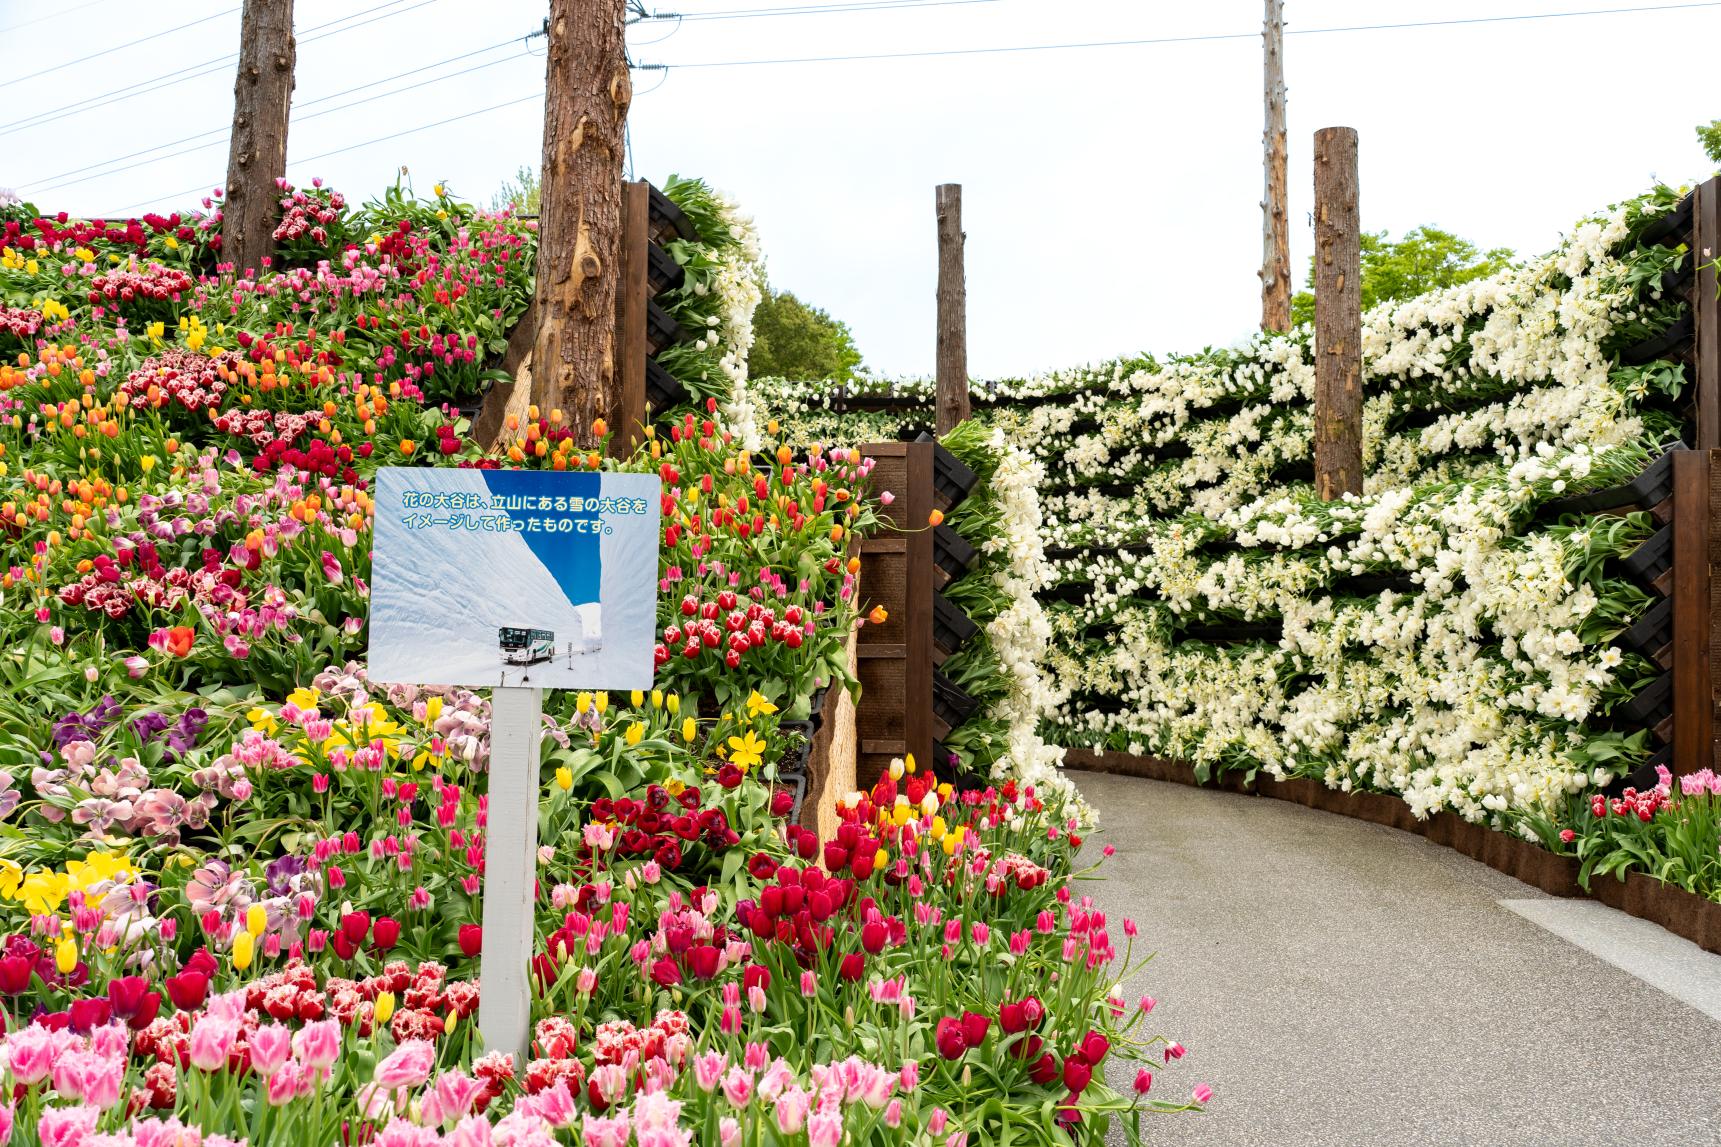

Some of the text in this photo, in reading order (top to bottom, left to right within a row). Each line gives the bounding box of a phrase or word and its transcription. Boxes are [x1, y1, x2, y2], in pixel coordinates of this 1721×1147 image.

[402, 490, 647, 514] 花の大谷は、立山にある雪の大谷を
[402, 513, 613, 535] イメージして作ったものです。
